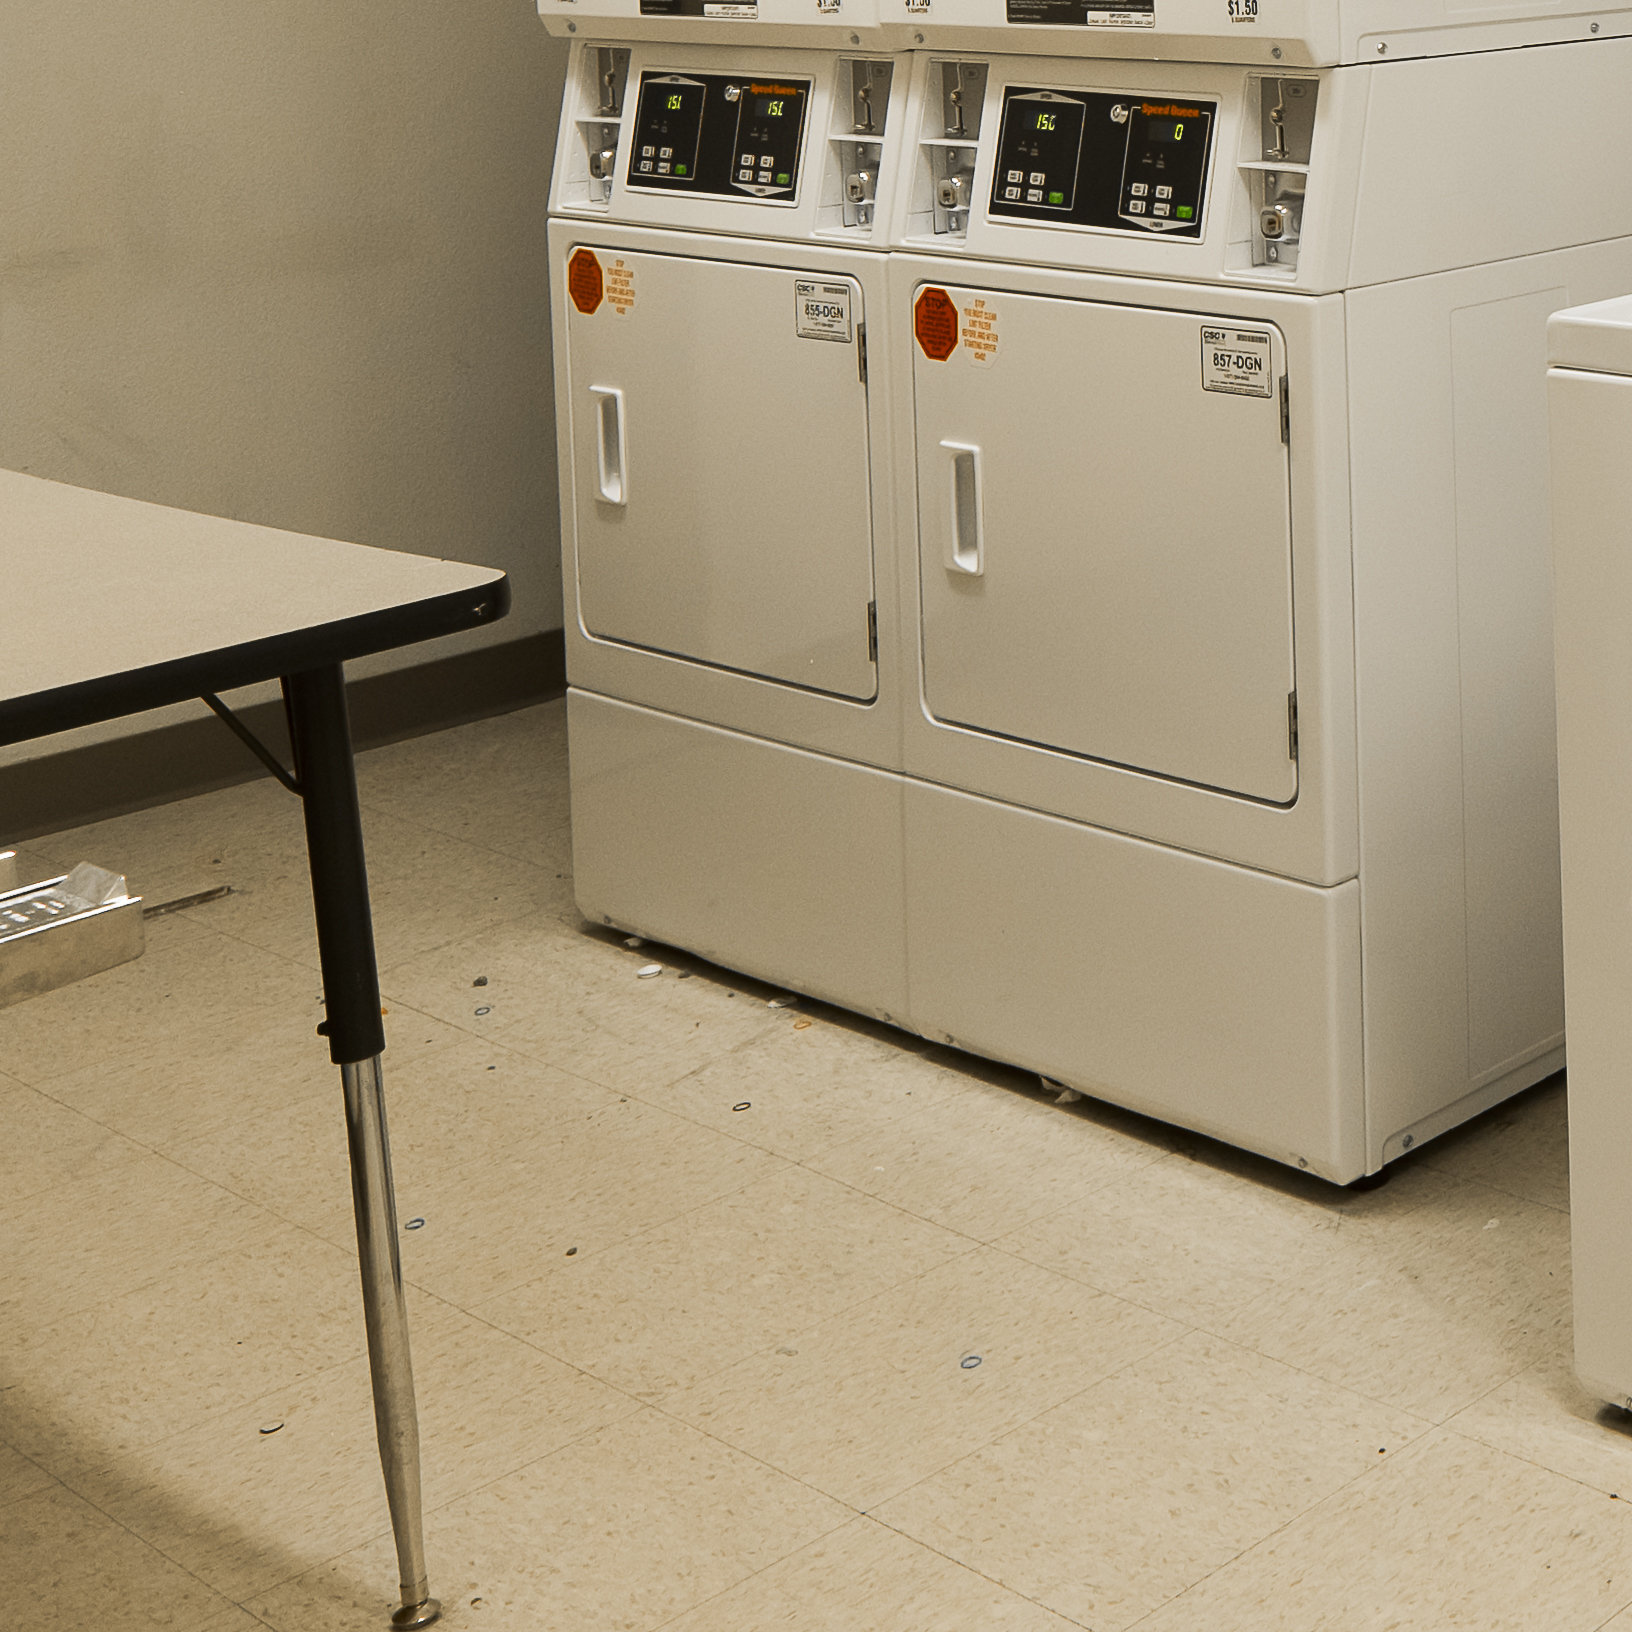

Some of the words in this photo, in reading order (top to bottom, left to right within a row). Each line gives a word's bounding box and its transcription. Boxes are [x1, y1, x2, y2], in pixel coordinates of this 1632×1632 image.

[1227, 0, 1258, 16] $1.50
[1141, 103, 1169, 117] Speed
[1171, 105, 1200, 118] Queen
[1174, 124, 1184, 141] 0
[1213, 352, 1262, 372] 857-DGN
